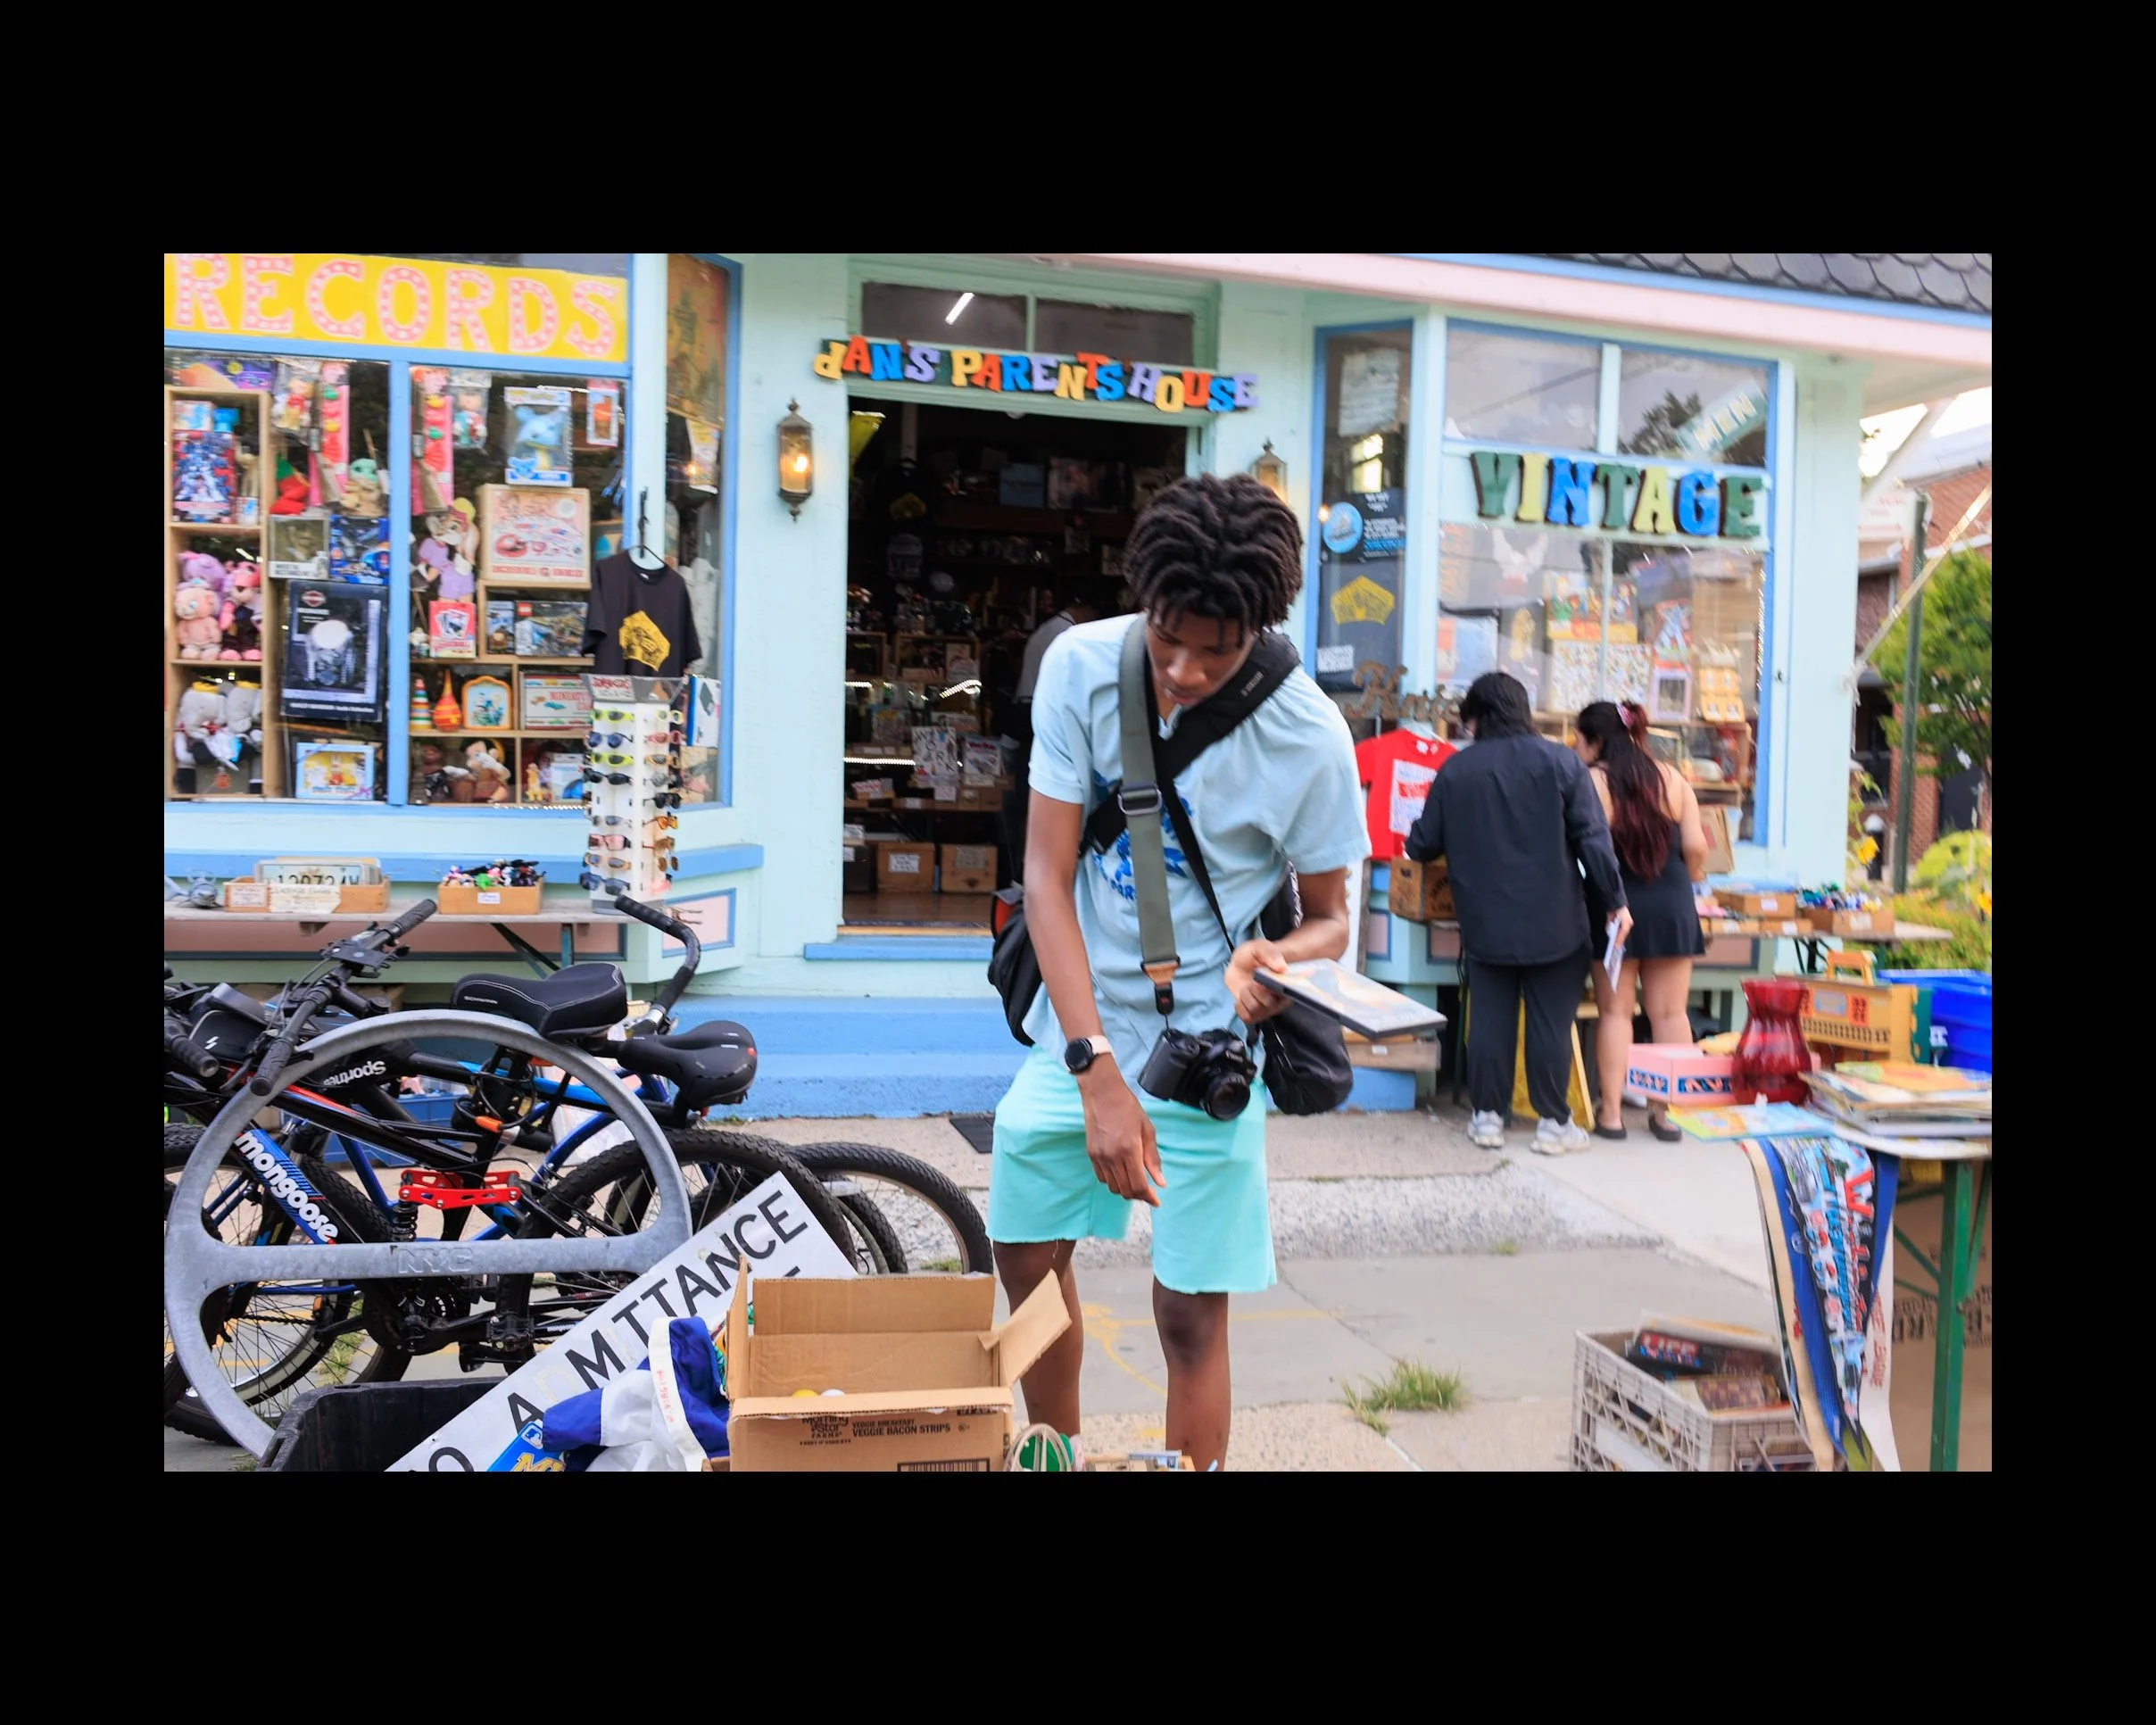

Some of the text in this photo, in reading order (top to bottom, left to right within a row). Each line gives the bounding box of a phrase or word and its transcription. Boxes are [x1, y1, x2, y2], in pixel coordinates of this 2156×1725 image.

[173, 253, 620, 357] RECORDS
[1126, 360, 1259, 413] HOUSE
[1470, 451, 1764, 536] VINTAGE
[234, 1130, 339, 1243] mongoose
[398, 1248, 475, 1273] NYC
[852, 1423, 951, 1438] VEGGIE BACON STRIPS
